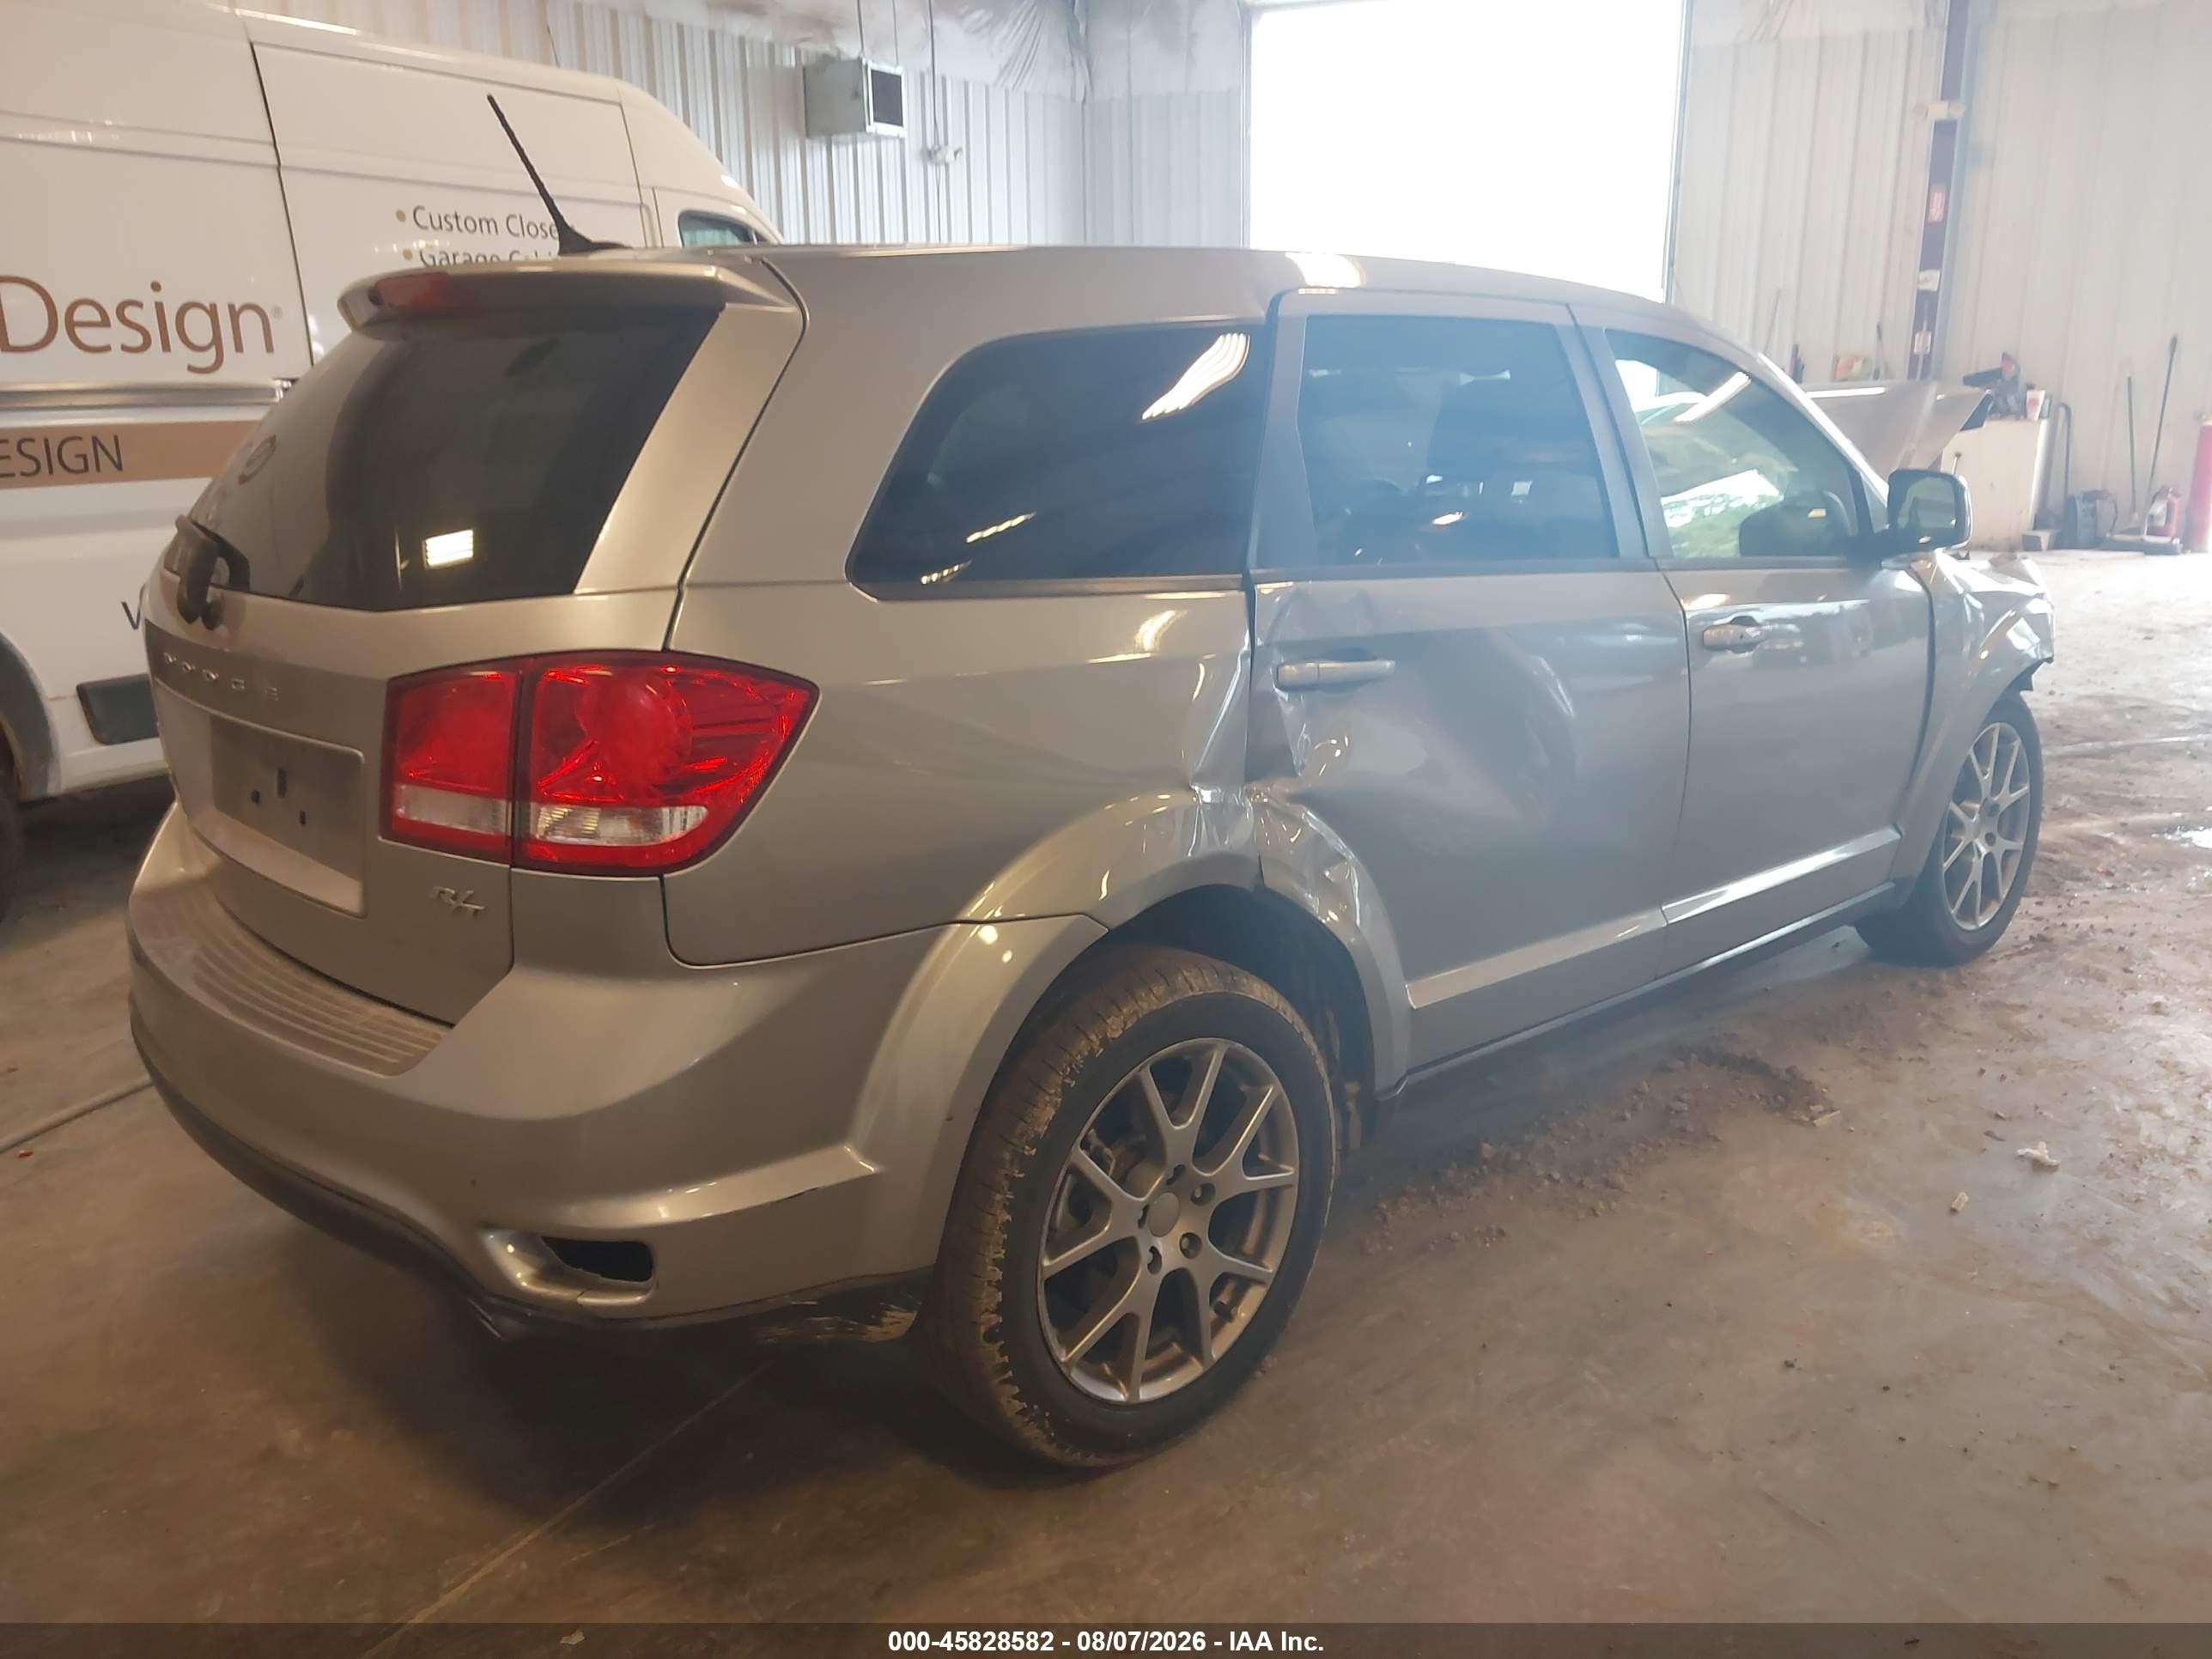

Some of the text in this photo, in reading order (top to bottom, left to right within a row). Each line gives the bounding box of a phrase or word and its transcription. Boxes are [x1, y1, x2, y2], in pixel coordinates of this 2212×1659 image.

[412, 205, 574, 240] Custom Close
[0, 275, 275, 374] Design
